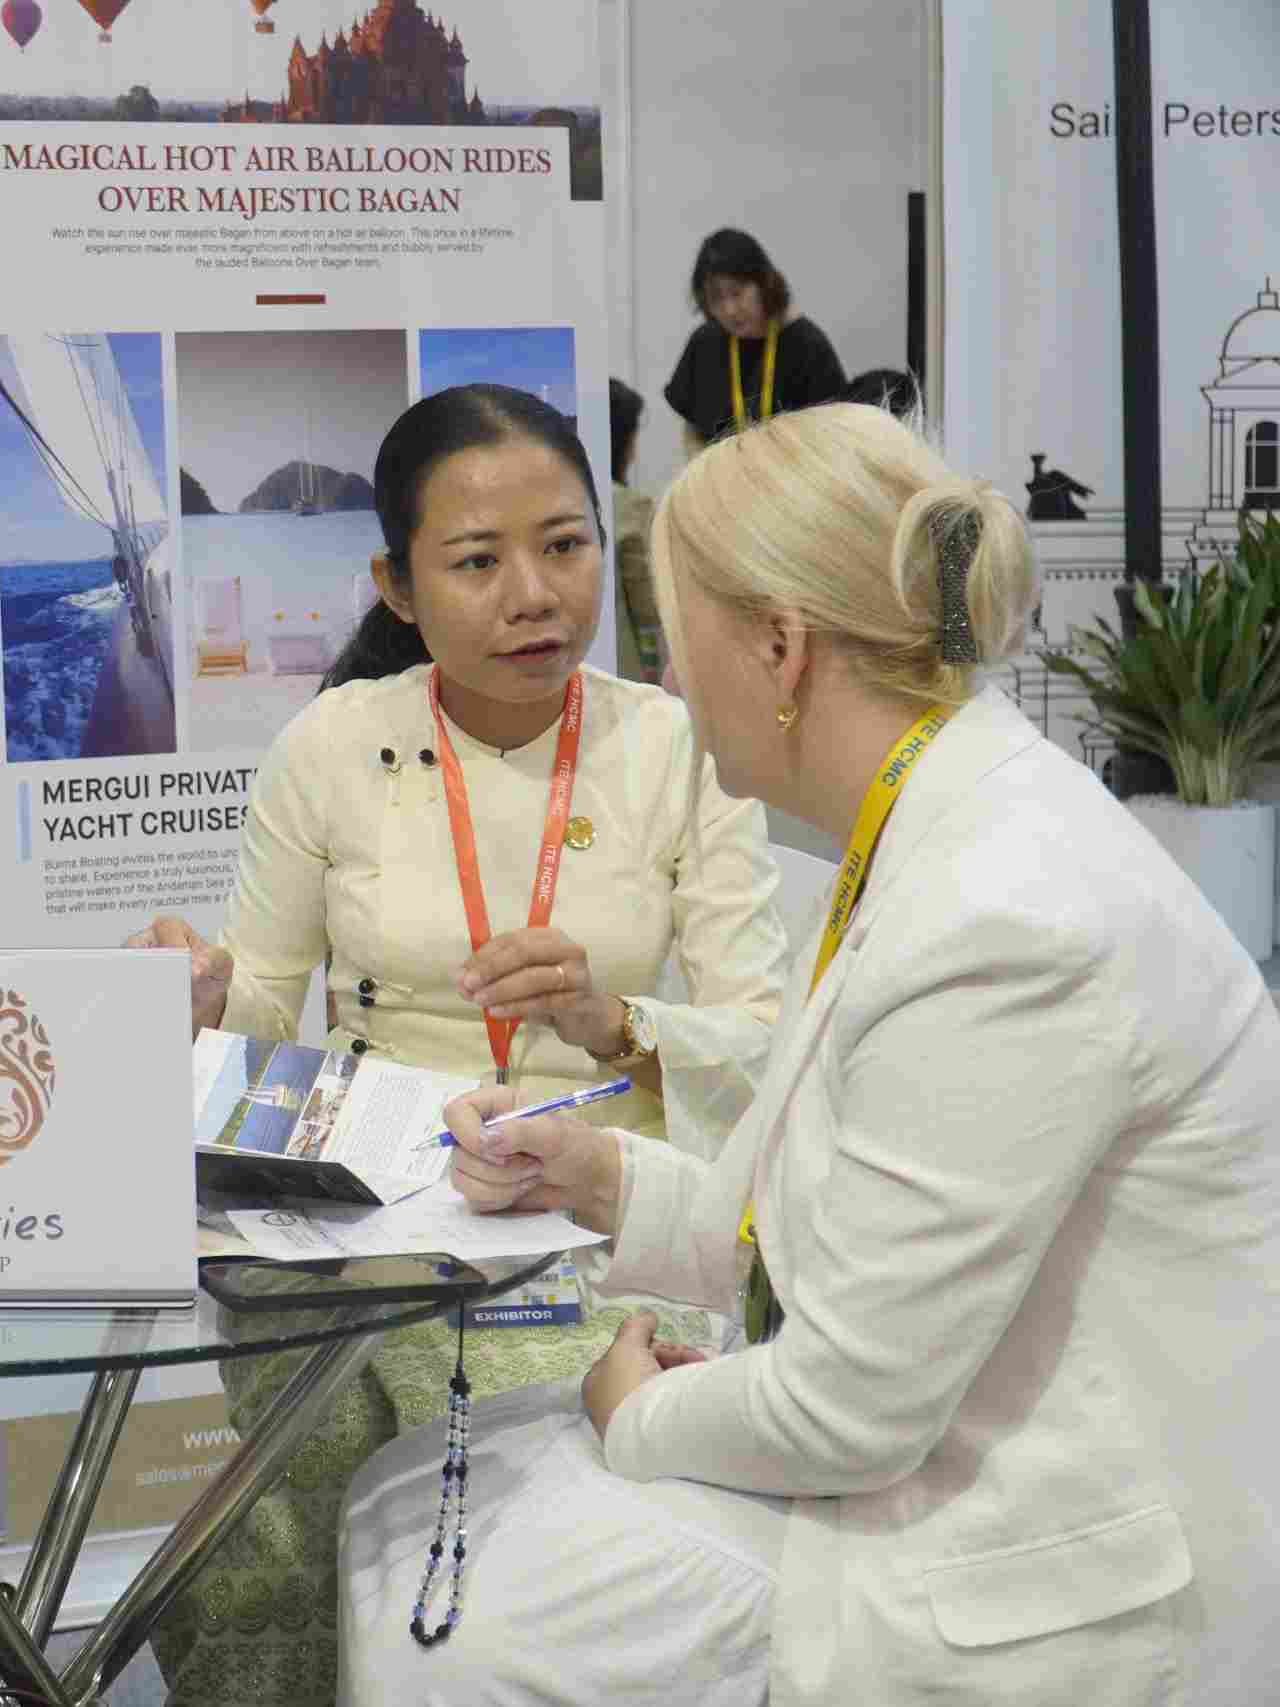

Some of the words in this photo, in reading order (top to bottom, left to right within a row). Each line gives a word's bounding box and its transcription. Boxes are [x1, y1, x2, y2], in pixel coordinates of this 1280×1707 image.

[1050, 102, 1111, 138] Sai
[2, 144, 157, 172] MAGICAL
[163, 145, 237, 172] HOT
[245, 145, 299, 173] AIR
[305, 147, 455, 173] BALLOON
[463, 148, 552, 175] RIDES
[98, 186, 190, 213] OVER
[197, 186, 350, 220] MAJESTIC
[359, 187, 463, 213] BAGAN
[882, 737, 924, 787] HCMC
[42, 774, 150, 805] MERGUI
[160, 768, 258, 798] PRIVAT
[43, 812, 133, 842] YACHT
[474, 1310, 553, 1322] EXHIBITOR
